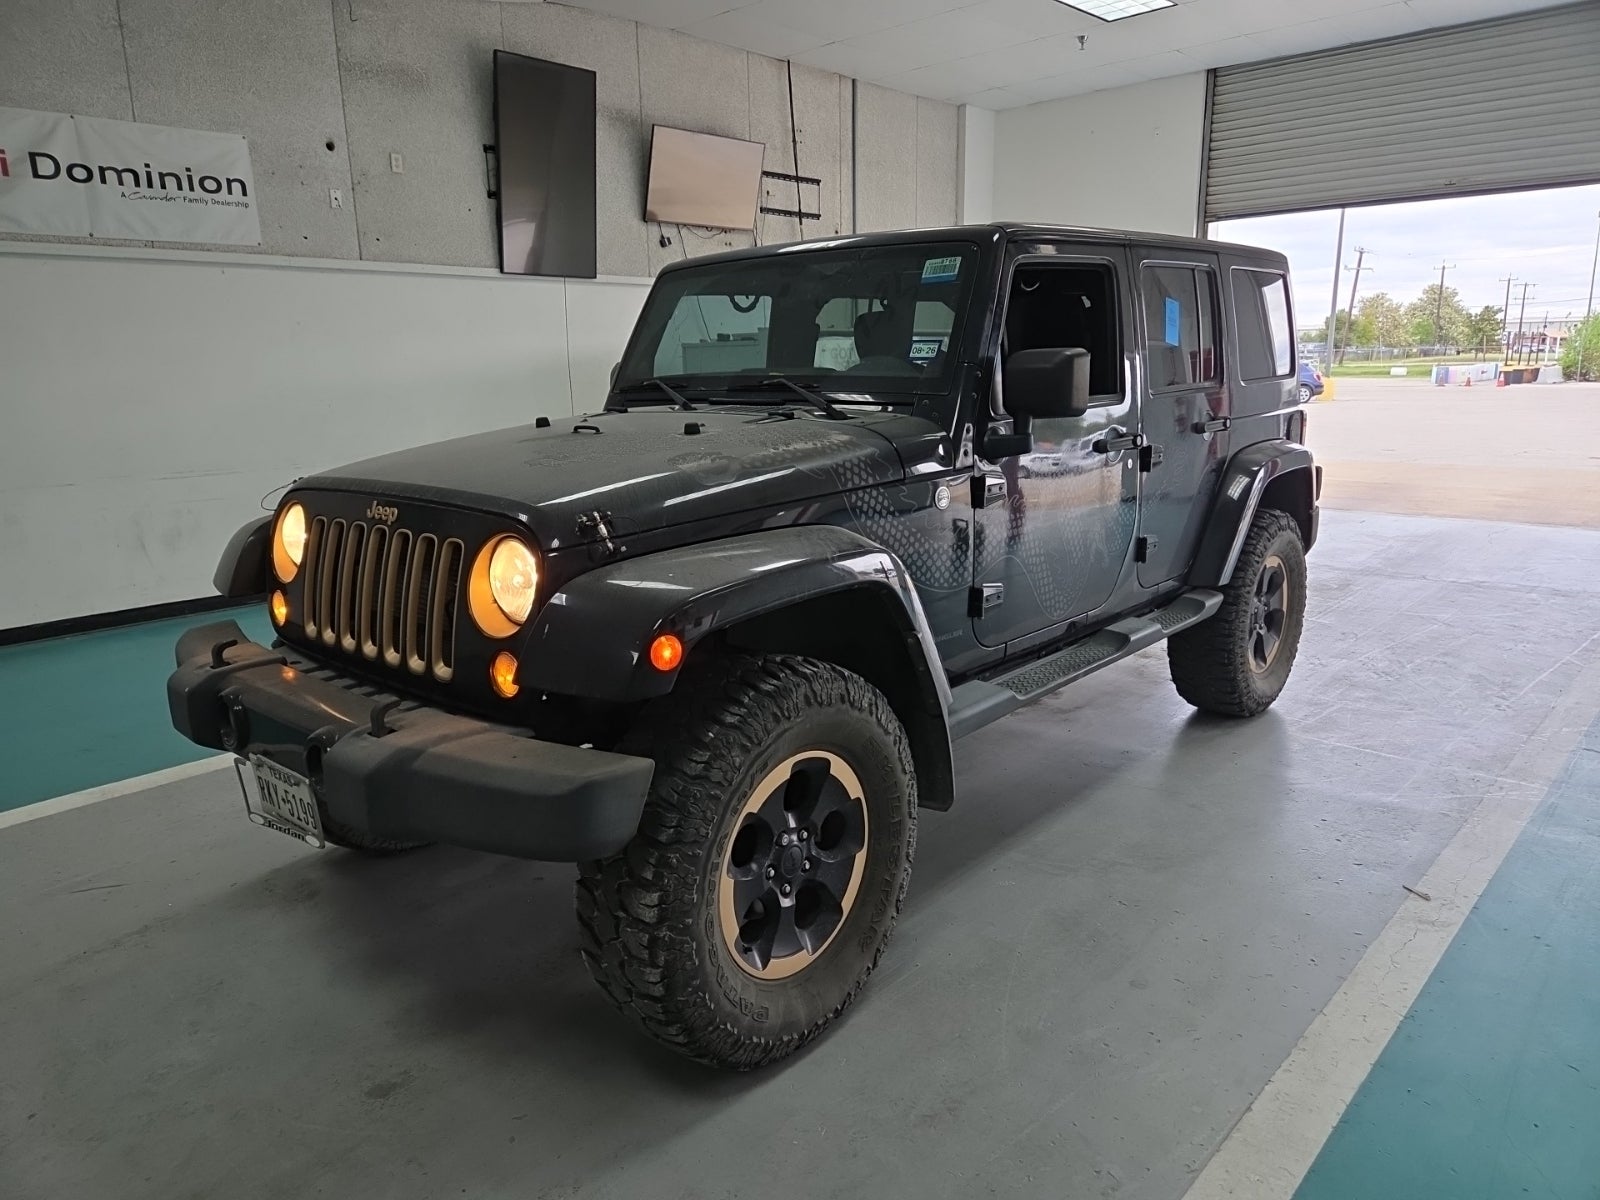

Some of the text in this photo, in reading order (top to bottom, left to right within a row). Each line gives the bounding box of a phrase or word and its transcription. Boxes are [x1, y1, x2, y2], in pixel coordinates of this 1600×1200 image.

[28, 151, 248, 197] Dominion
[120, 192, 127, 200] A
[183, 196, 209, 206] Family
[211, 199, 250, 209] Dealership
[366, 500, 398, 525] Jeep
[264, 820, 307, 843] Jordan
